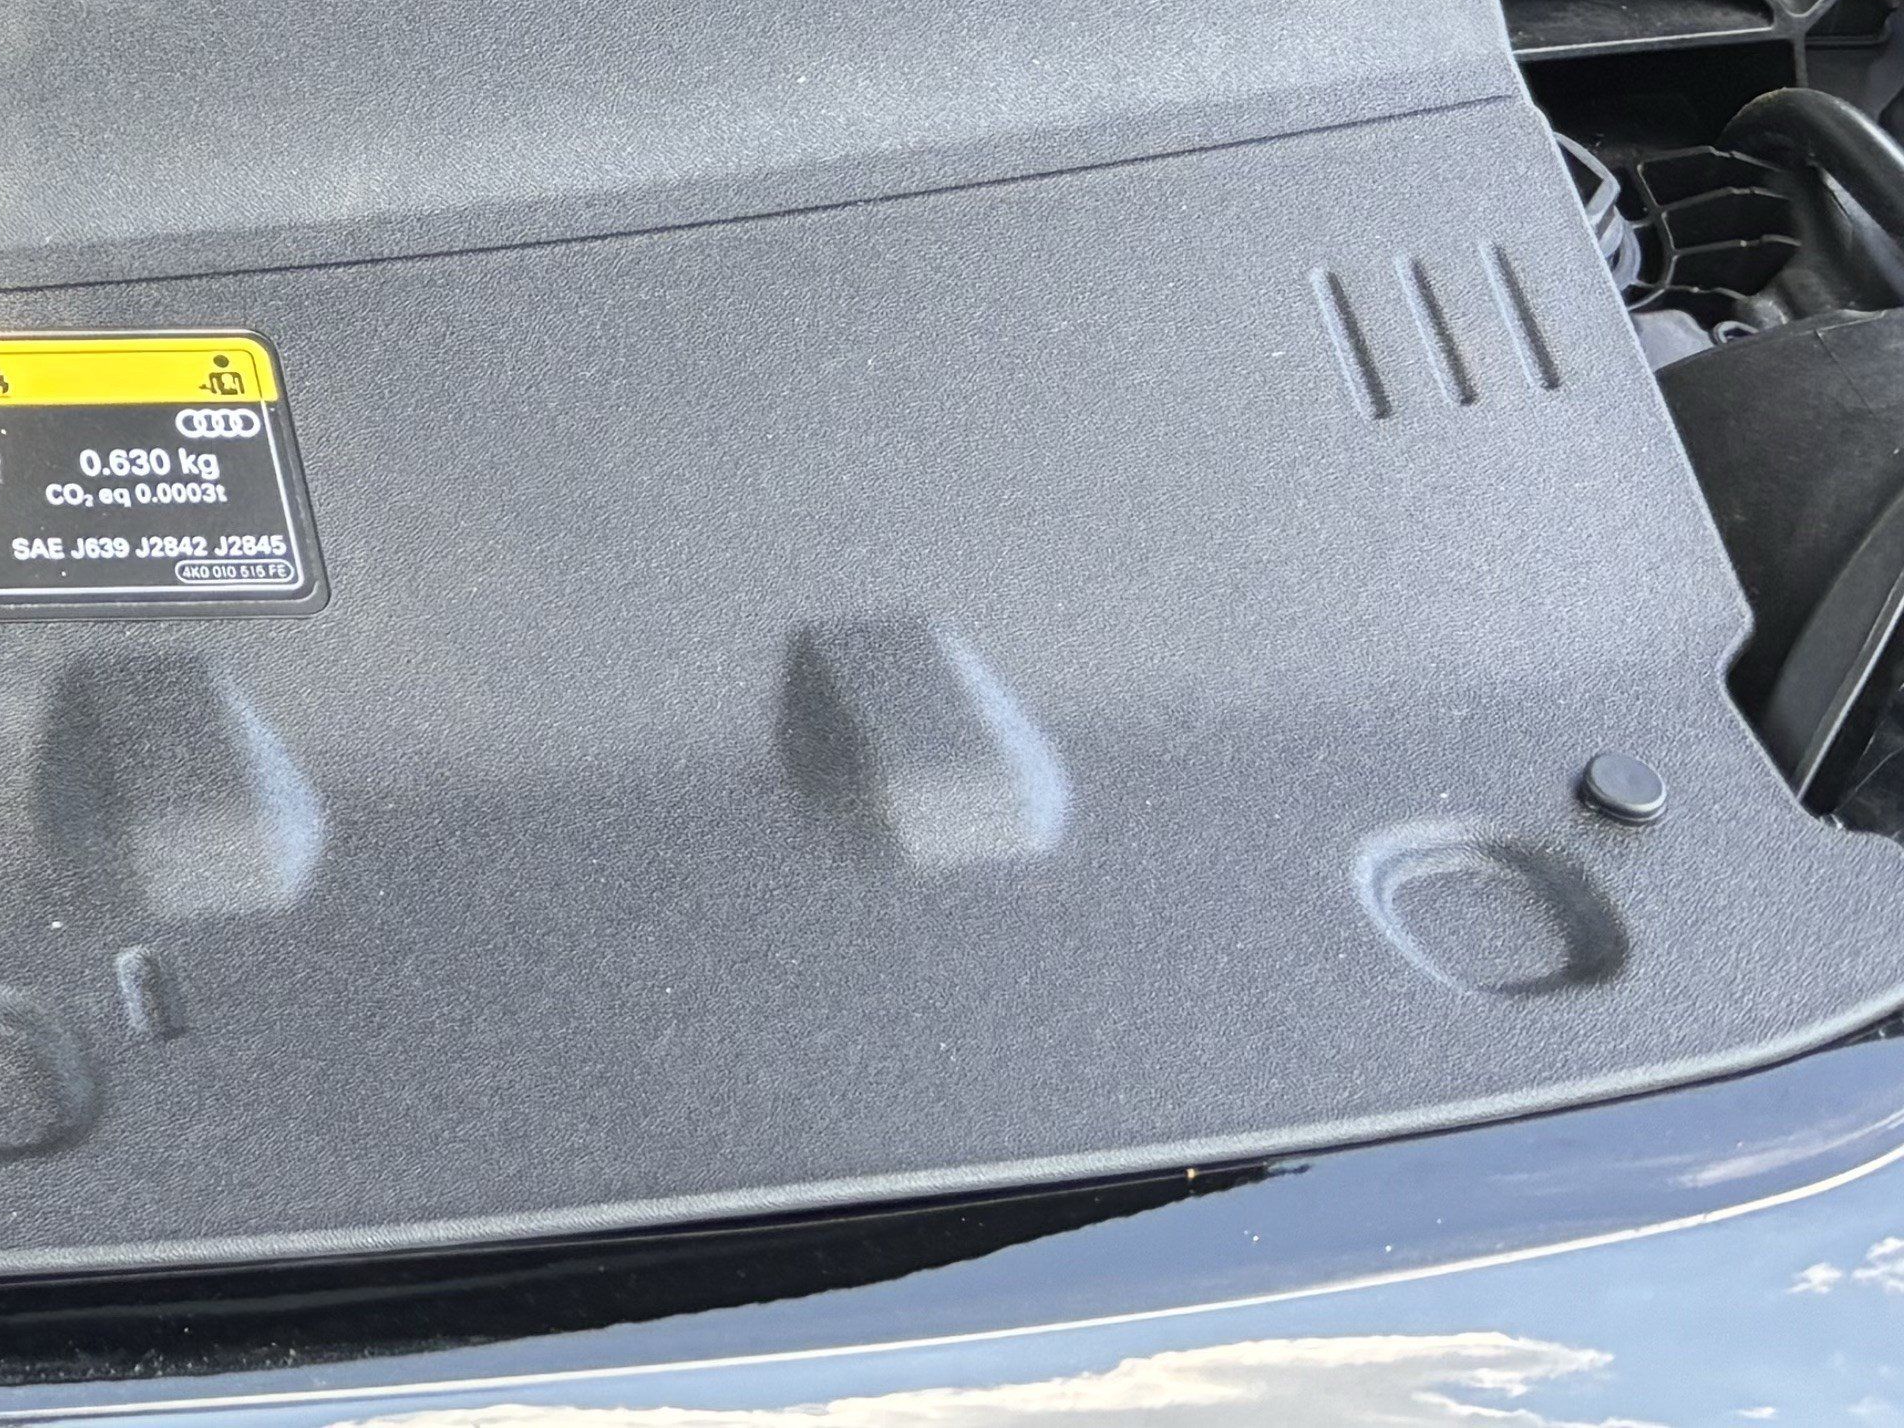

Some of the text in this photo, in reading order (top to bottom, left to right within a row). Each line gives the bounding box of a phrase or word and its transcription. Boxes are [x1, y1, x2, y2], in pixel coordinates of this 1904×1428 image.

[79, 447, 220, 480] 0.630 kg
[98, 488, 131, 507] eq
[134, 482, 227, 503] 0.0003t
[12, 534, 288, 560] SAE J639 J2842 J2845
[212, 565, 237, 578] 010
